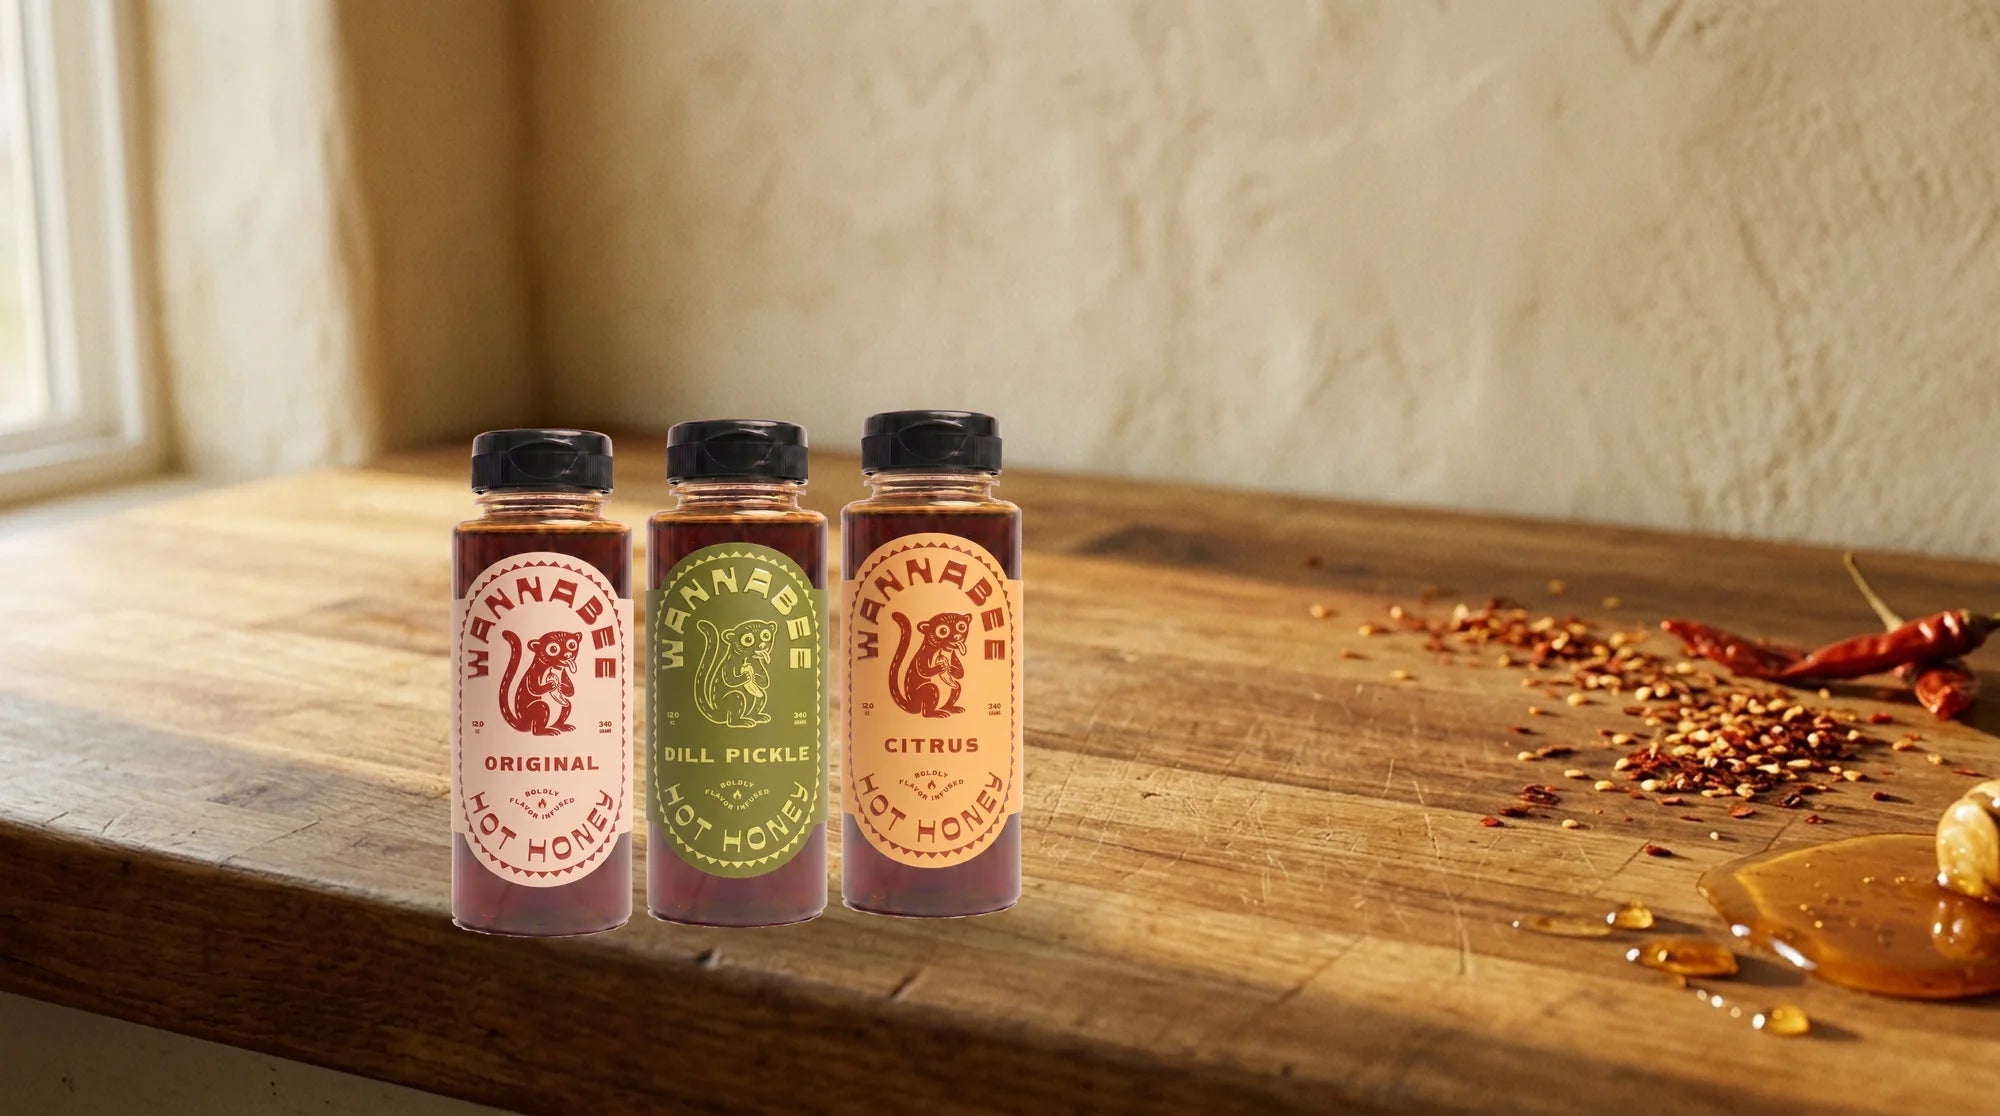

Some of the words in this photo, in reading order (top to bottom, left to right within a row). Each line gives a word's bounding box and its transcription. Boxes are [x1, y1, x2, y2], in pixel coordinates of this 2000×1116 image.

[662, 566, 811, 670] WANNABEE
[857, 557, 1005, 661] WANNABEE
[467, 576, 616, 679] WANNABEE
[664, 747, 715, 763] DILL
[726, 746, 810, 763] PICKLE
[884, 738, 979, 754] CITRUS
[484, 756, 599, 772] ORIGINAL
[914, 770, 949, 779] BOLDLY
[524, 788, 559, 797] BOLDLY
[720, 780, 755, 789] BOLDLY
[898, 779, 928, 801] FLAVOR
[931, 779, 964, 801] INFUSED
[509, 798, 538, 819] FLAVOR
[541, 797, 575, 819] INFUSED
[704, 789, 734, 810] FLAVOR
[736, 788, 769, 811] INFUSED
[859, 773, 907, 831] HOT
[917, 771, 1003, 843] HONEY
[470, 791, 517, 850] HOT
[528, 789, 614, 863] HONEY
[664, 783, 713, 841] HOT
[722, 781, 808, 853] HONEY
